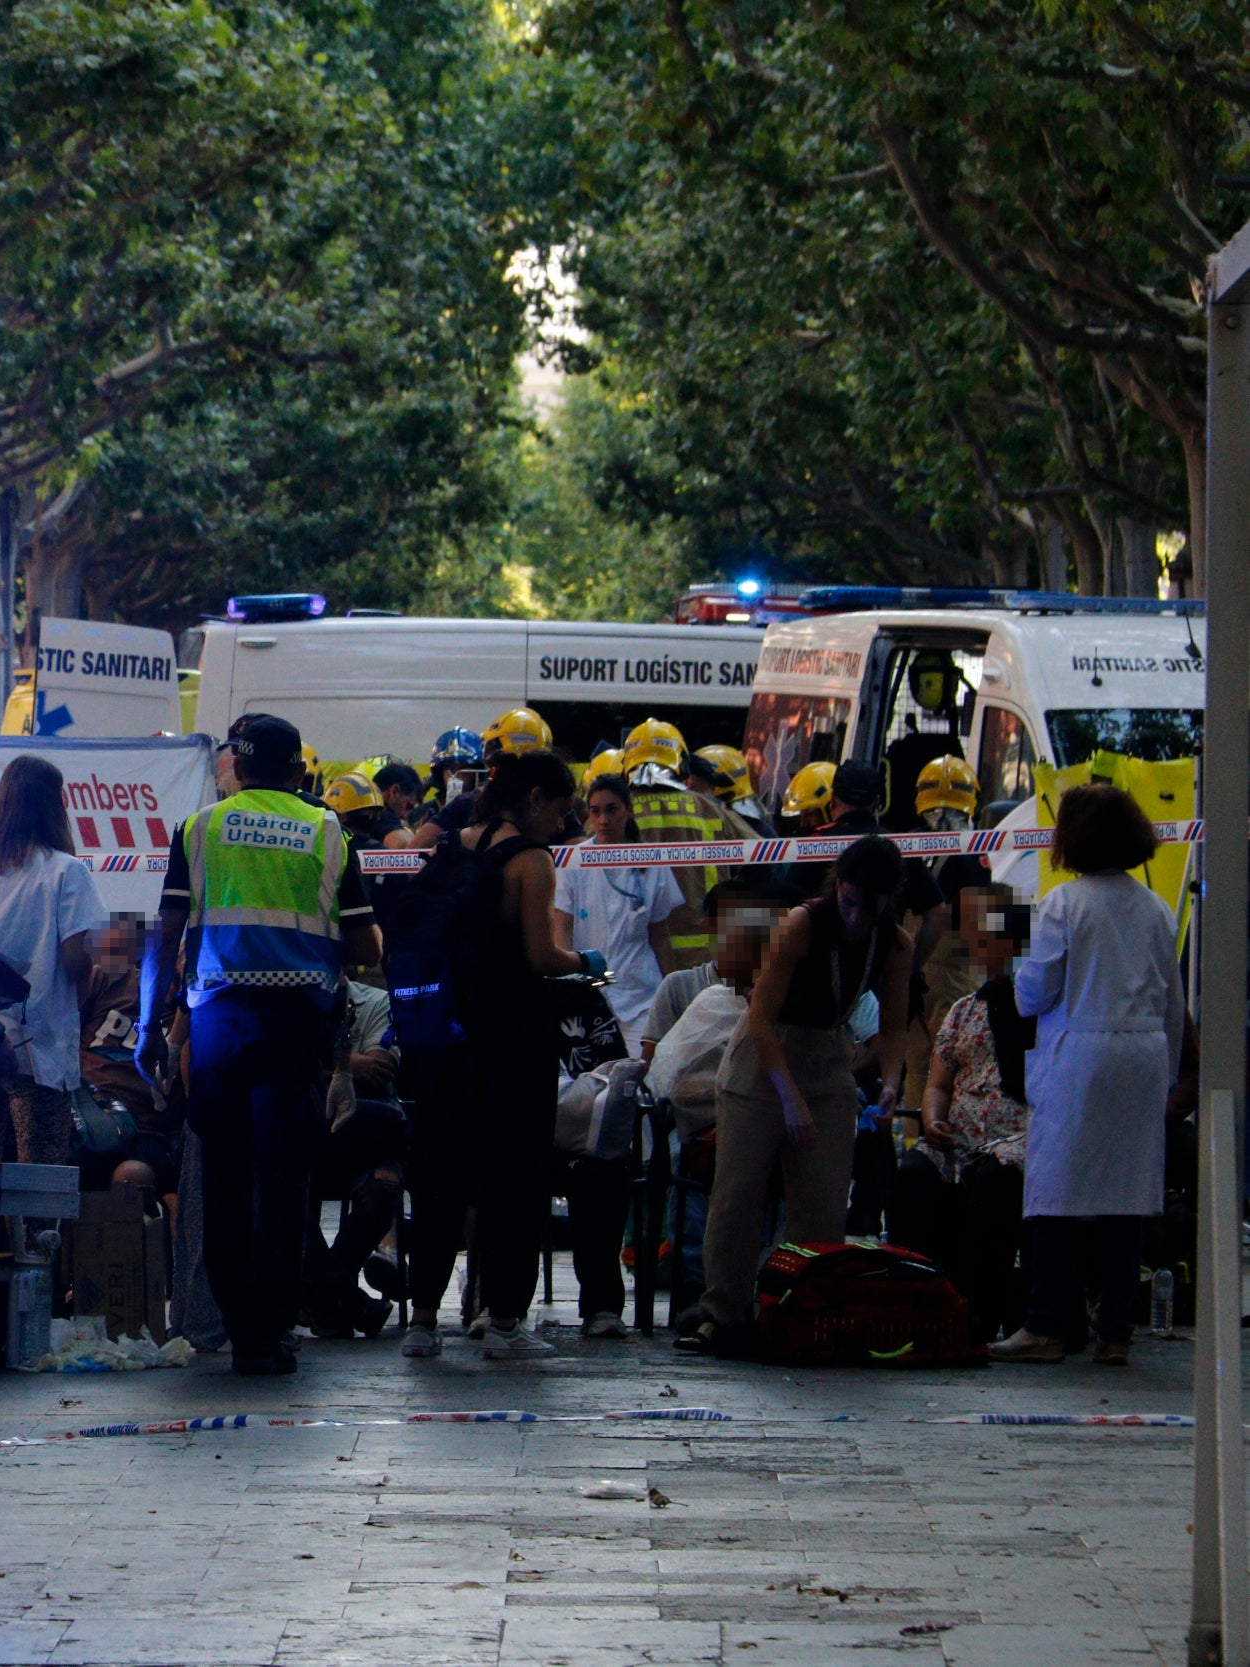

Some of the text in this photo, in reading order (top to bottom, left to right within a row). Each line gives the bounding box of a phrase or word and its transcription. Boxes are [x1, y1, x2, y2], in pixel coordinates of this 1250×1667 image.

[81, 651, 171, 681] SANITARI
[540, 656, 617, 681] SUPORT
[624, 654, 712, 685] LOGÍSTIC
[228, 829, 306, 849] Urbana
[630, 848, 662, 861] MOSSOS
[702, 846, 731, 858] PASSEU
[394, 982, 440, 997] FITNESS PARK
